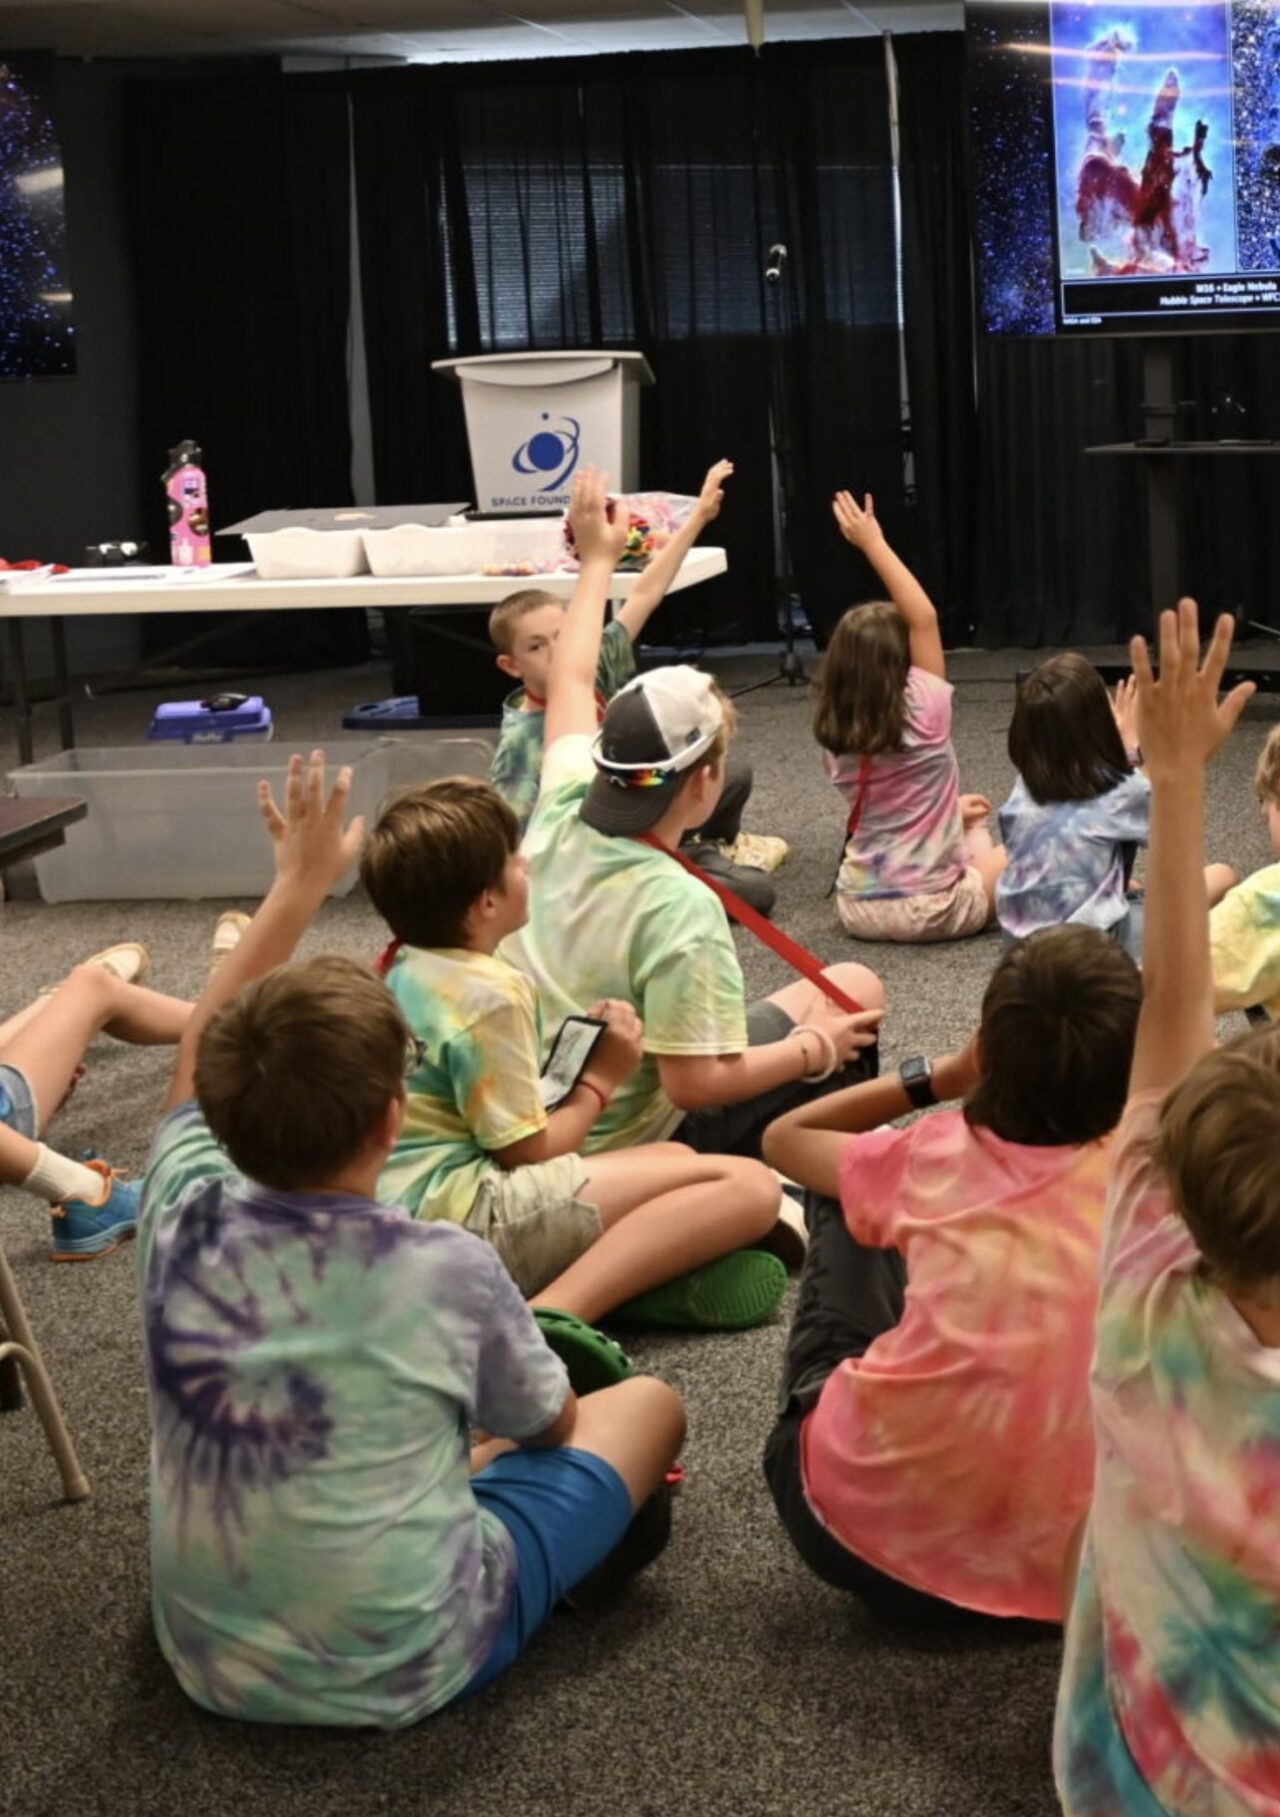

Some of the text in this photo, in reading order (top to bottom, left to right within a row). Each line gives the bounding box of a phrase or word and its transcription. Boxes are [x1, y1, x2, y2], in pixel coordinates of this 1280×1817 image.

[1196, 281, 1277, 293] M16 Eagle Nebula
[1160, 295, 1187, 306] Hubble
[1189, 294, 1212, 306] Space
[1214, 293, 1254, 305] Telescope
[491, 495, 527, 507] SPACE
